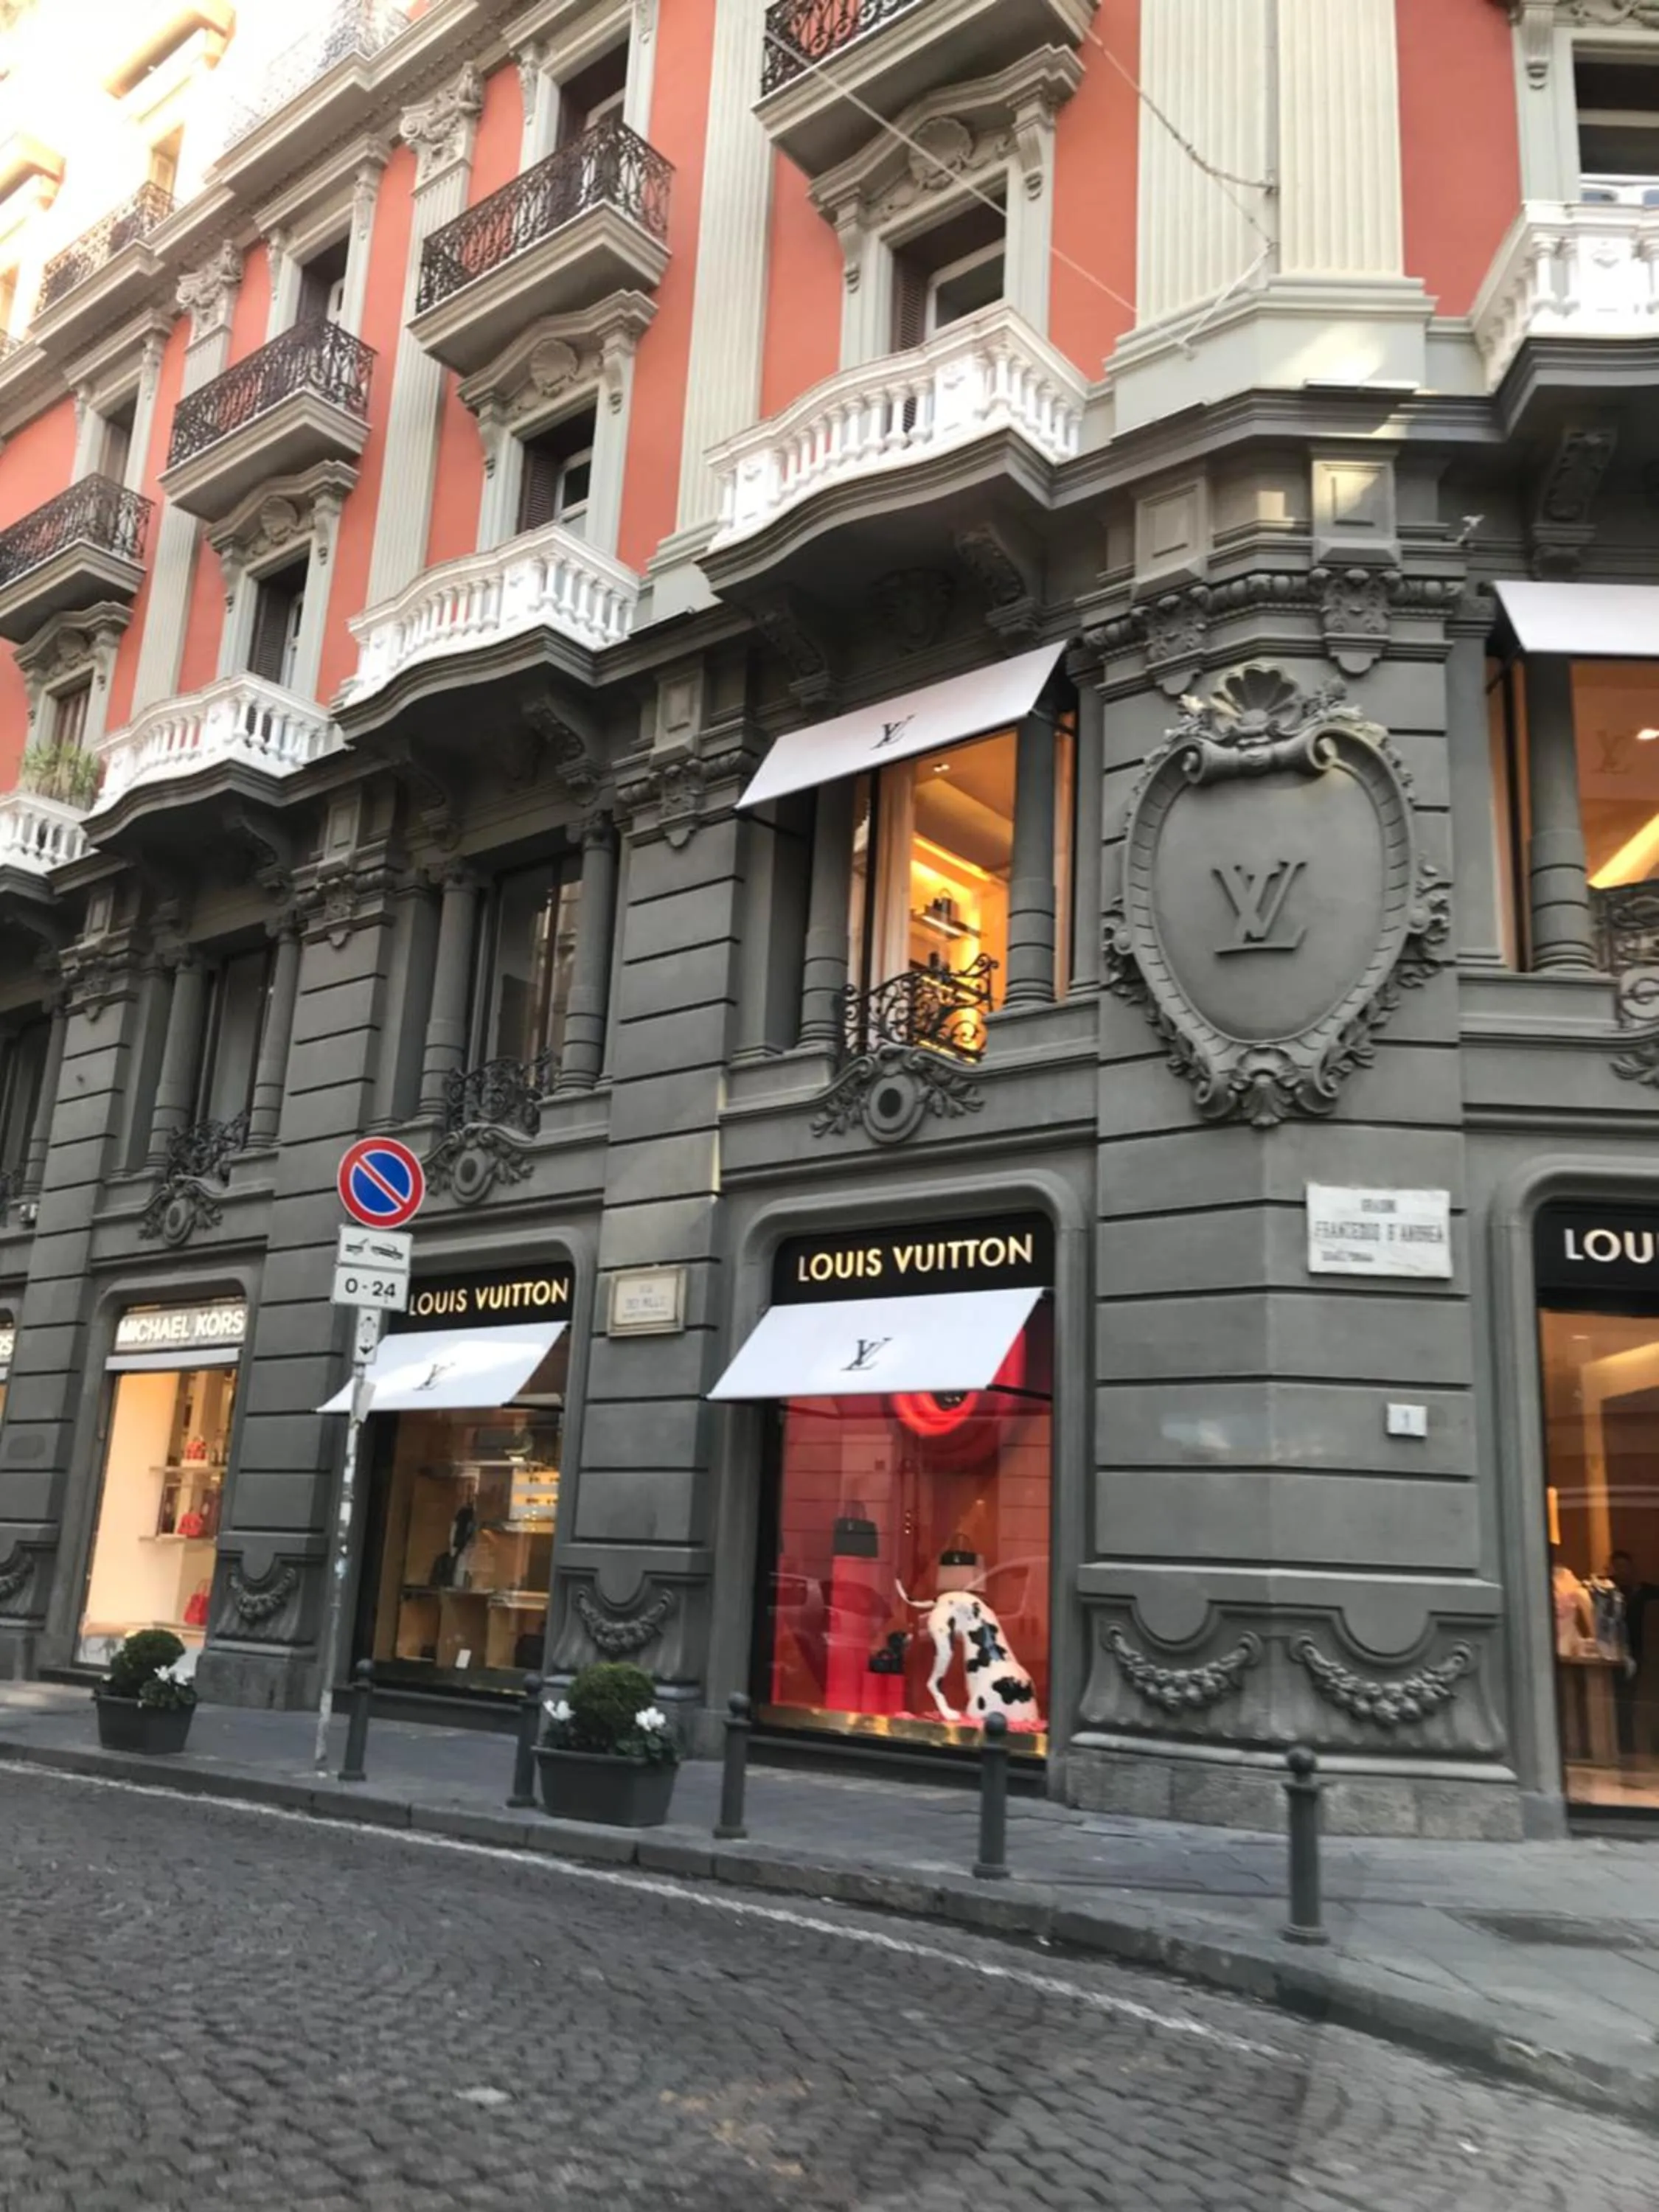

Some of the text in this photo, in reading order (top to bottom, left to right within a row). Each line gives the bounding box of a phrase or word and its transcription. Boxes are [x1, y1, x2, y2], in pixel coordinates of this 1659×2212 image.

[798, 1233, 1032, 1281] LOUIS VUITTON
[1564, 1228, 1659, 1264] LOU
[409, 1277, 568, 1316] LOUIS VUITTON
[117, 1310, 244, 1342] MICHAEL KORS
